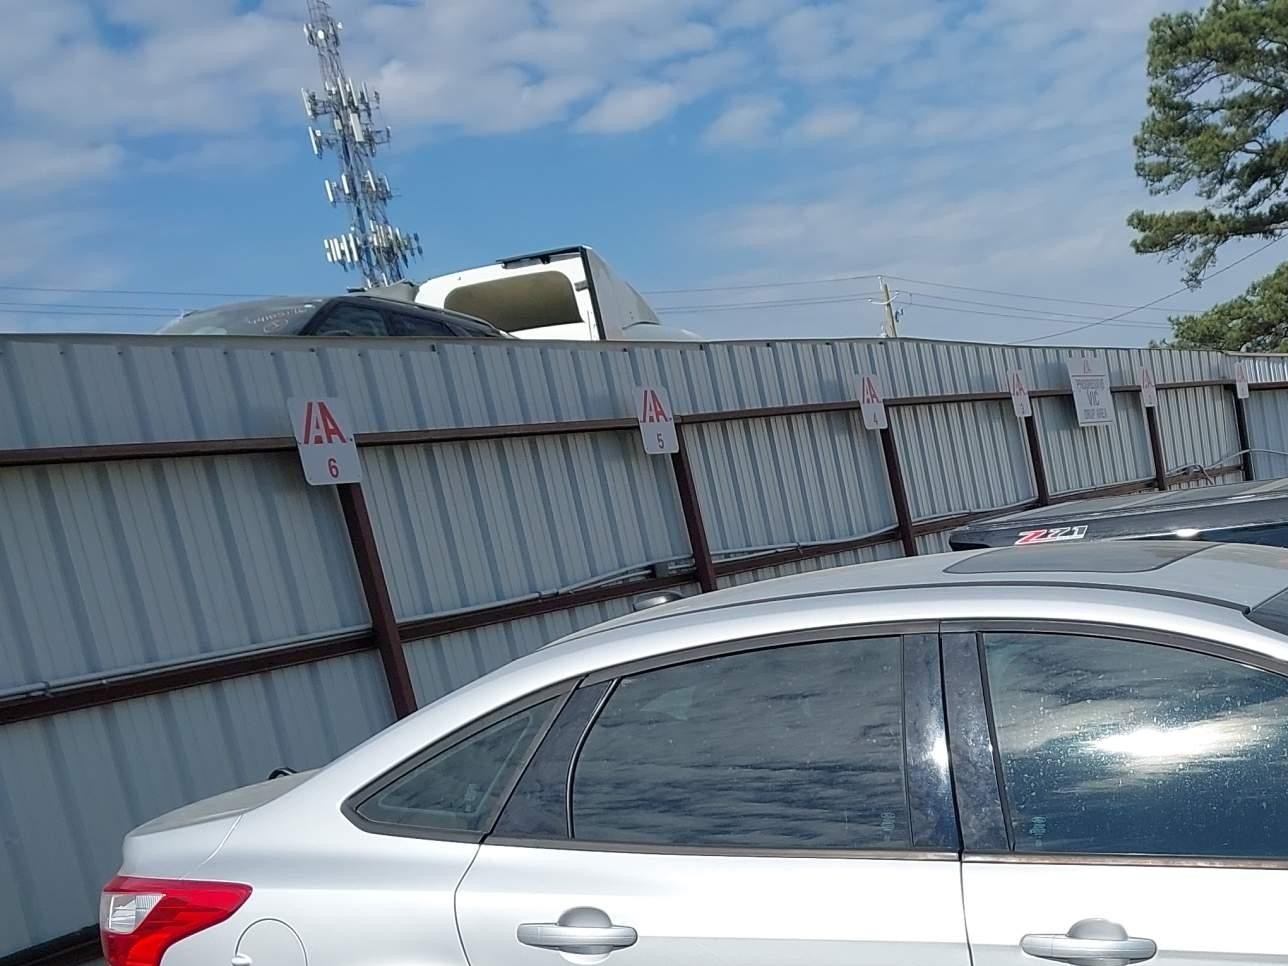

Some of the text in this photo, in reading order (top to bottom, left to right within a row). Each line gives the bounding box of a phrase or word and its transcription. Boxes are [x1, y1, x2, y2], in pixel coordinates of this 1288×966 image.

[871, 411, 879, 426] 4
[656, 432, 665, 449] 5
[327, 457, 340, 479] 6
[1014, 524, 1089, 545] Z71
